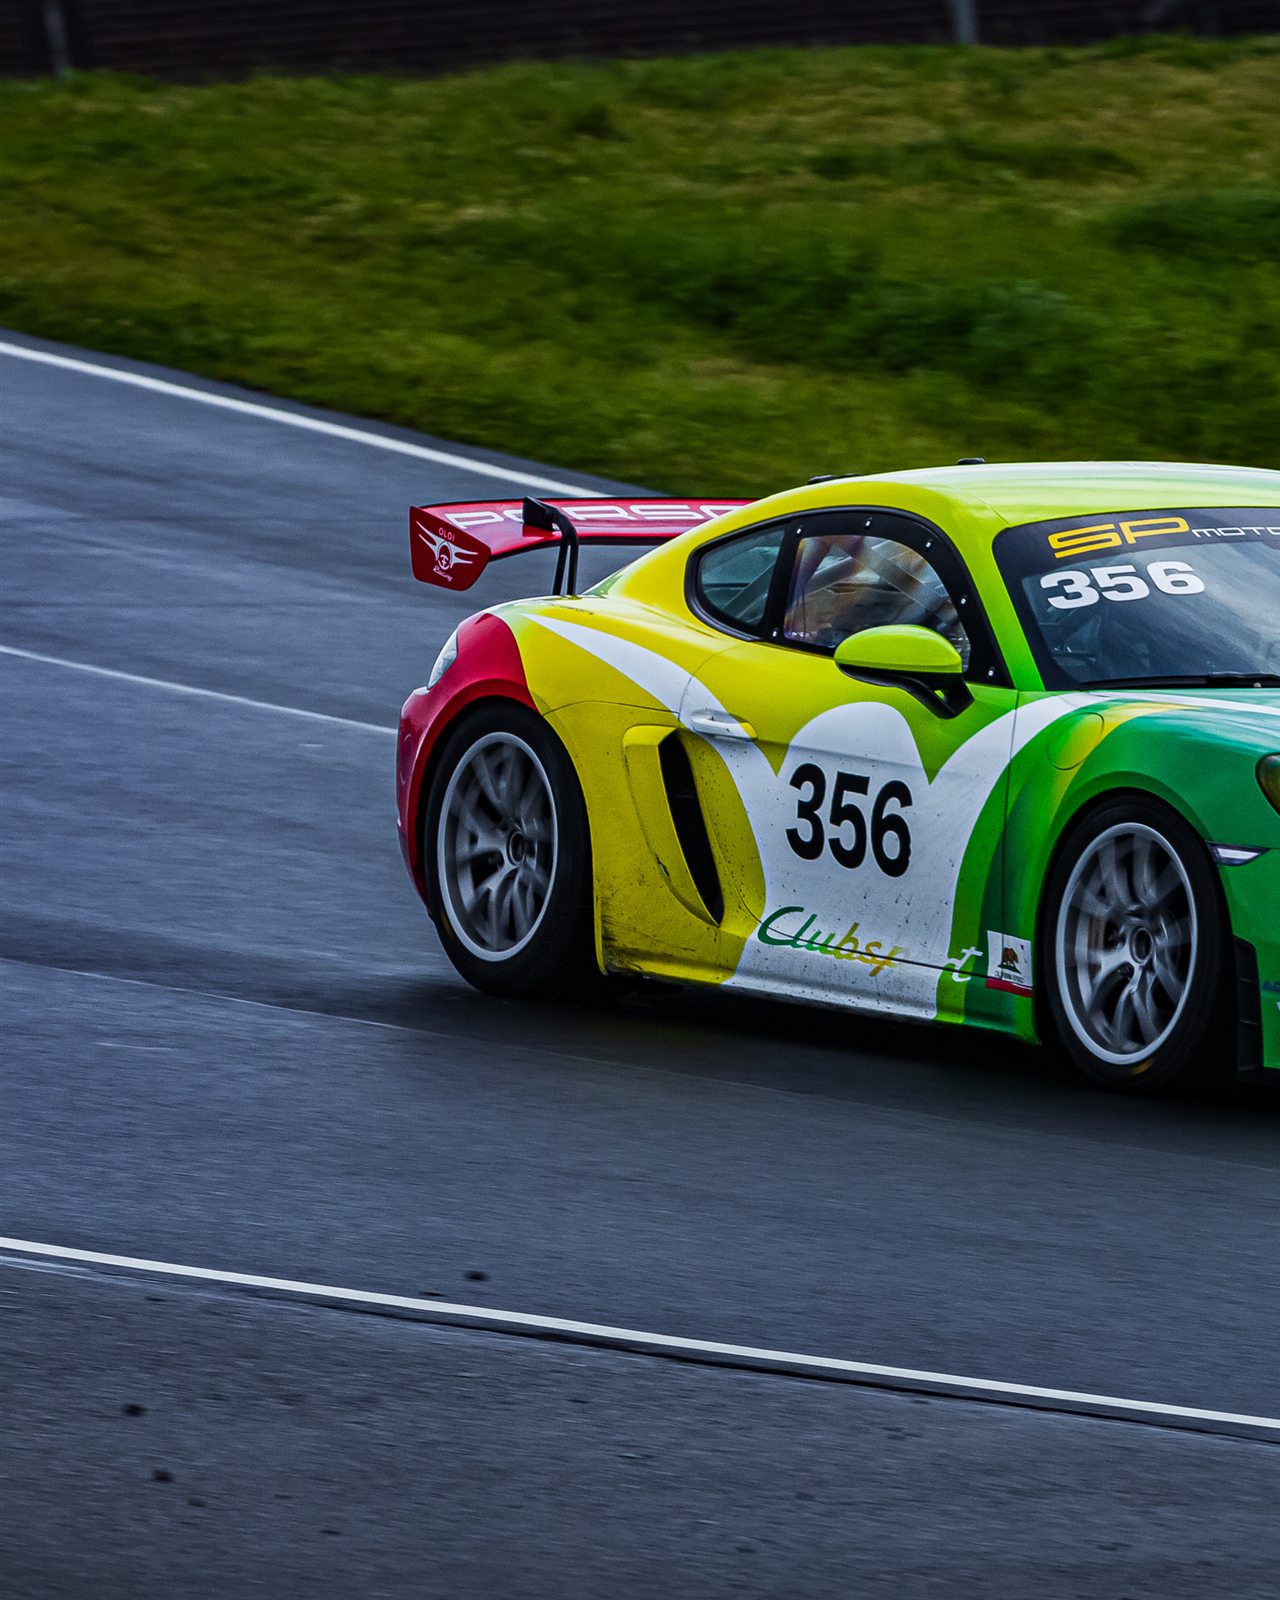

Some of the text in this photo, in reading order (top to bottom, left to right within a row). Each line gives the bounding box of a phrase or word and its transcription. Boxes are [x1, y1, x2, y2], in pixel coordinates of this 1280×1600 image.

[438, 527, 455, 541] OLOI
[1047, 516, 1191, 559] SP
[1039, 560, 1206, 610] 356
[785, 763, 913, 878] 356
